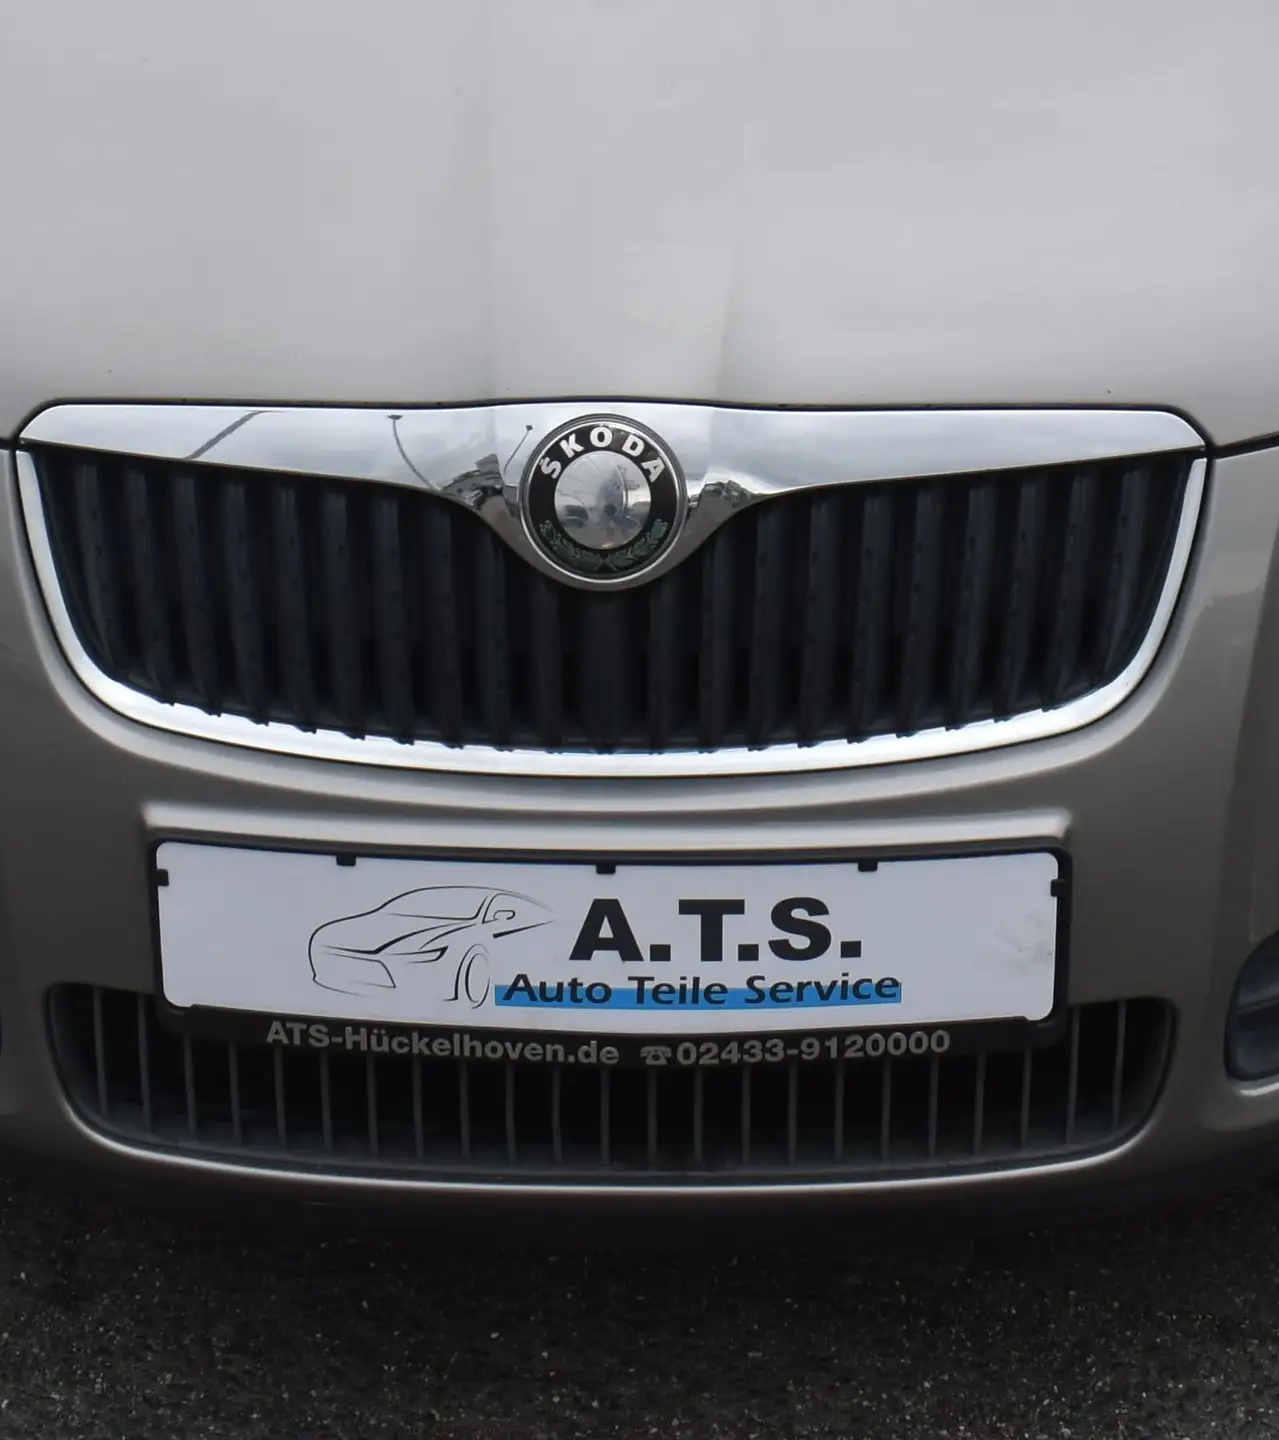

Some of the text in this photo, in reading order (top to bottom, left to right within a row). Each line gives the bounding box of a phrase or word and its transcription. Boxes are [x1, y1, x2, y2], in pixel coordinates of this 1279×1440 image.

[568, 896, 862, 962] A.T.S.
[502, 972, 900, 1005] Auto Teile Service
[266, 1020, 620, 1065] ATS-Hückelhoven.de
